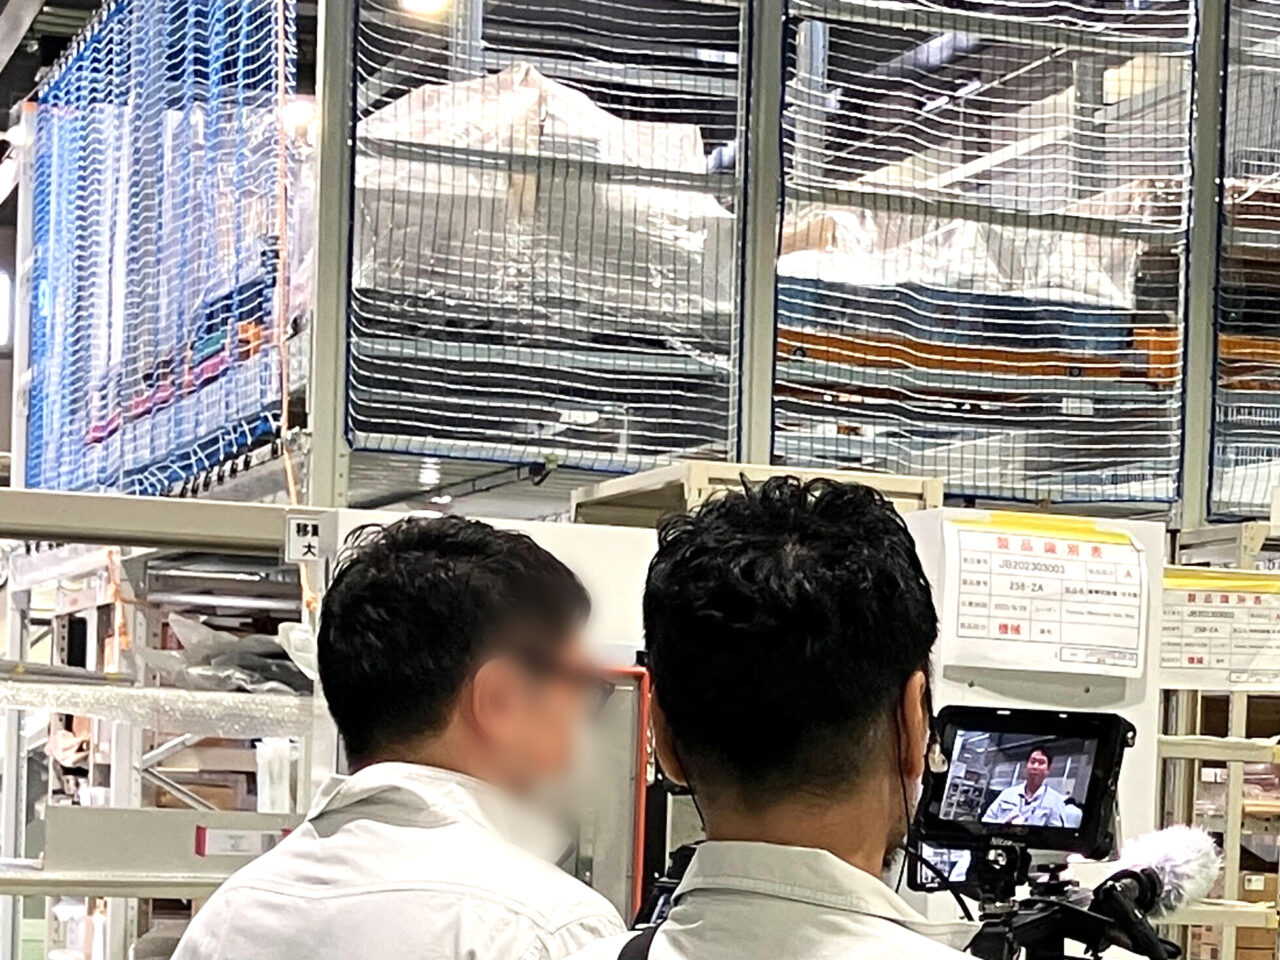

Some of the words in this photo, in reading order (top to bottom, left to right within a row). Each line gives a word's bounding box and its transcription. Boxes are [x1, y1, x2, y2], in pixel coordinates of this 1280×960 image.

[302, 541, 317, 557] 大
[997, 536, 1103, 559] 製品識別表
[1124, 569, 1133, 579] A
